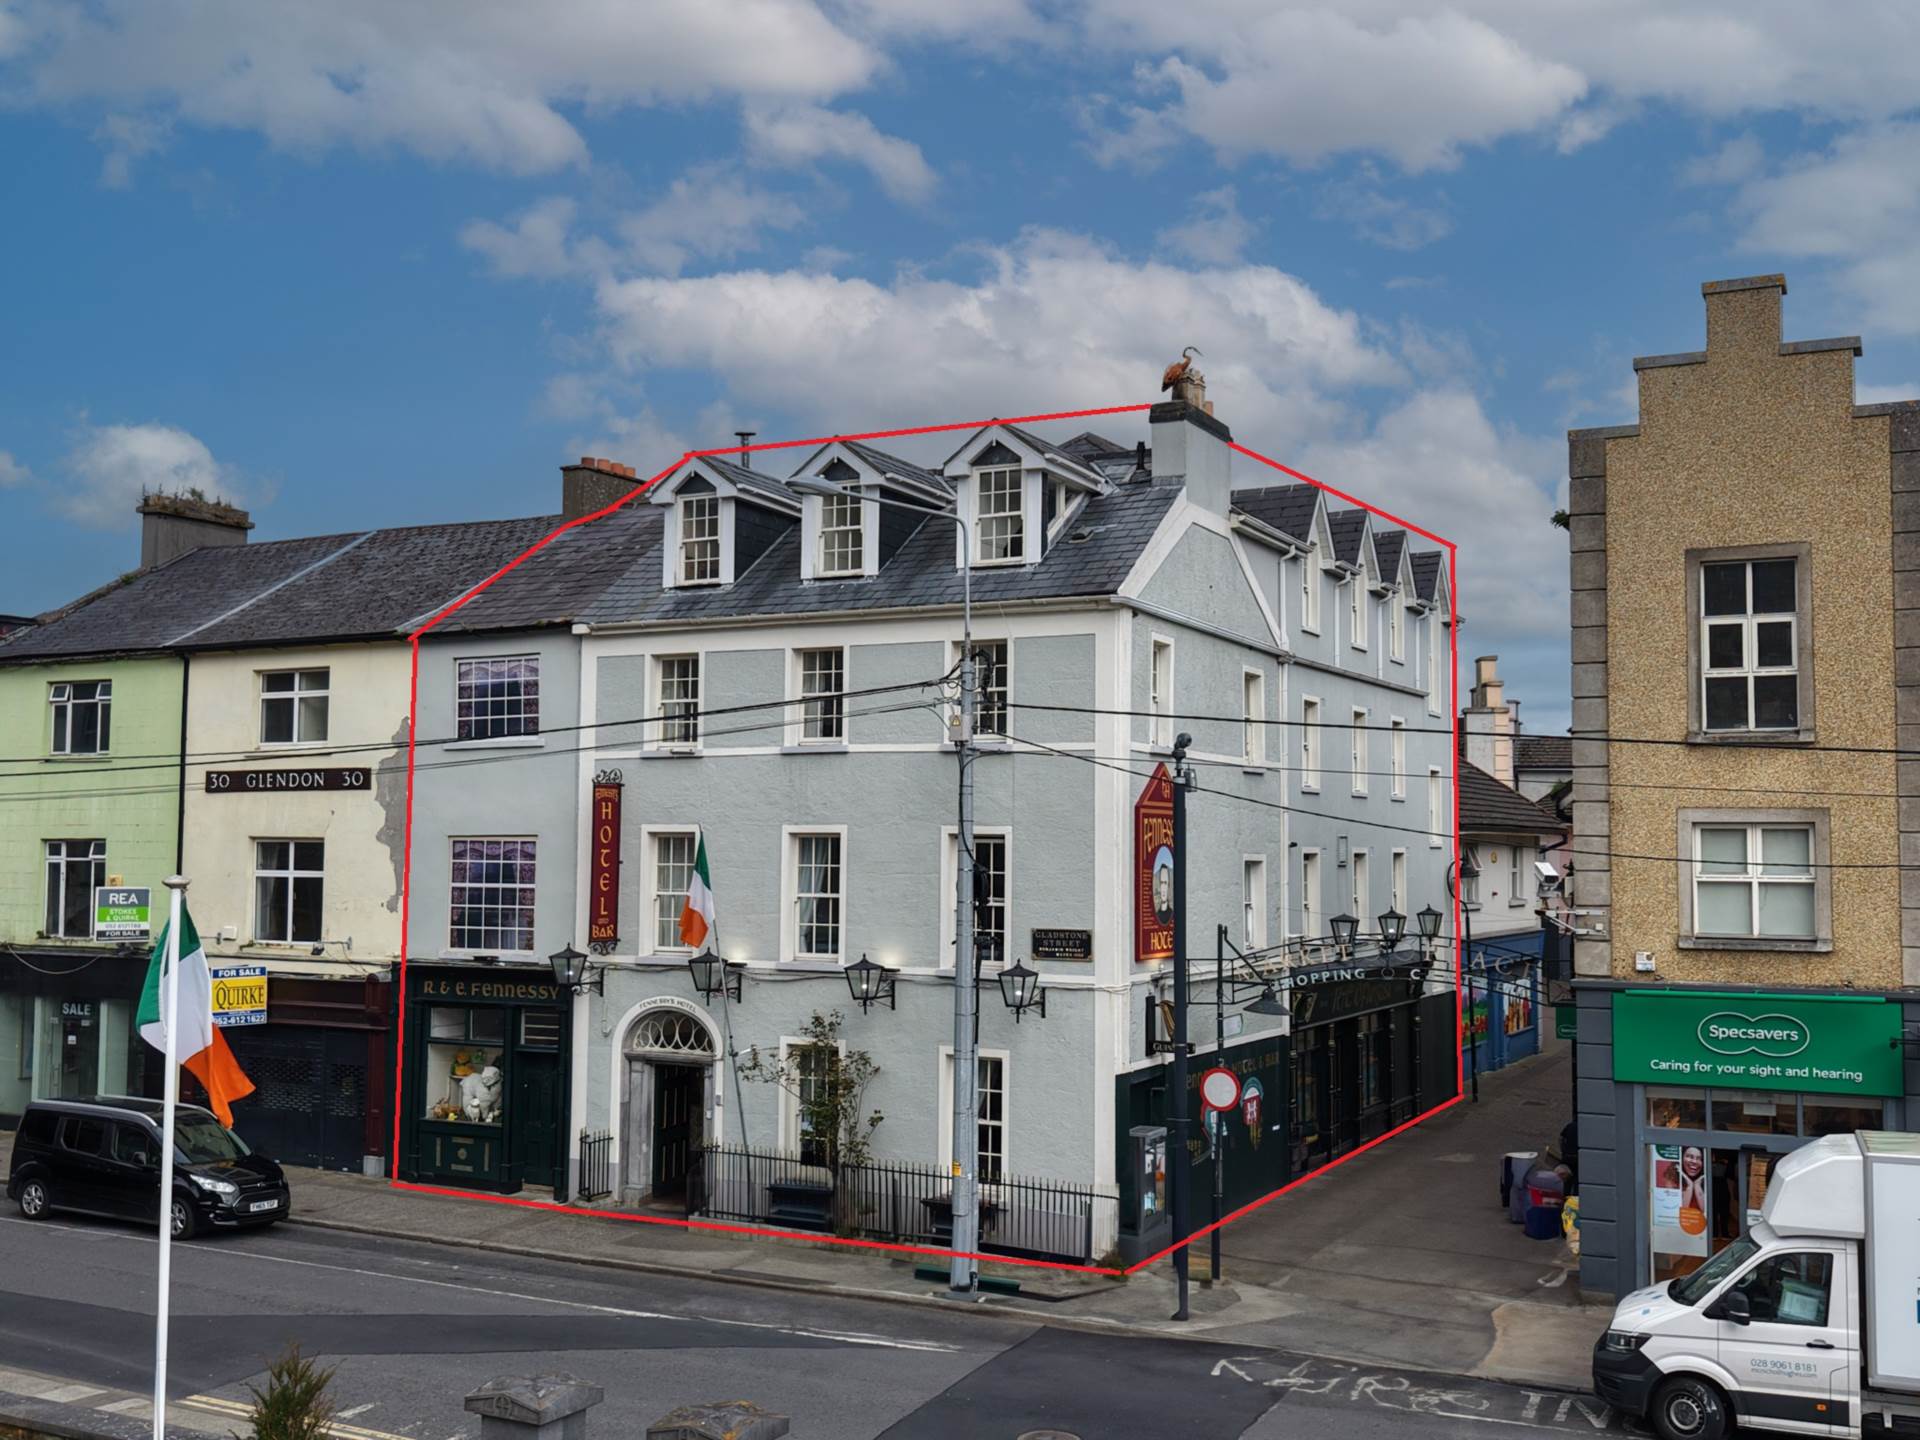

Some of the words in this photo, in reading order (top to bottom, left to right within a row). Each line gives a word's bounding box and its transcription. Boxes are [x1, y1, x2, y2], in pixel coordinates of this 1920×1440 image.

[210, 774, 230, 788] 30
[246, 772, 325, 788] GLENDON
[342, 771, 364, 786] 30
[599, 802, 612, 915] HOTEL
[109, 893, 138, 905] REA
[591, 925, 614, 938] BAR
[1034, 931, 1089, 939] GLADSTONE
[1042, 939, 1081, 947] STREET
[238, 968, 261, 976] SALE
[216, 986, 265, 1009] QUIRKE
[62, 1003, 91, 1015] SALE
[1709, 1025, 1799, 1041] Specsavers
[1650, 1059, 1690, 1073] Caring
[1694, 1060, 1713, 1072] for
[1717, 1064, 1746, 1075] your
[1749, 1064, 1782, 1078] sight
[1785, 1067, 1809, 1077] and
[1813, 1068, 1863, 1082] hearing
[1750, 1359, 1768, 1367] 028
[1770, 1360, 1792, 1369] 9061
[1794, 1362, 1817, 1372] 8181
